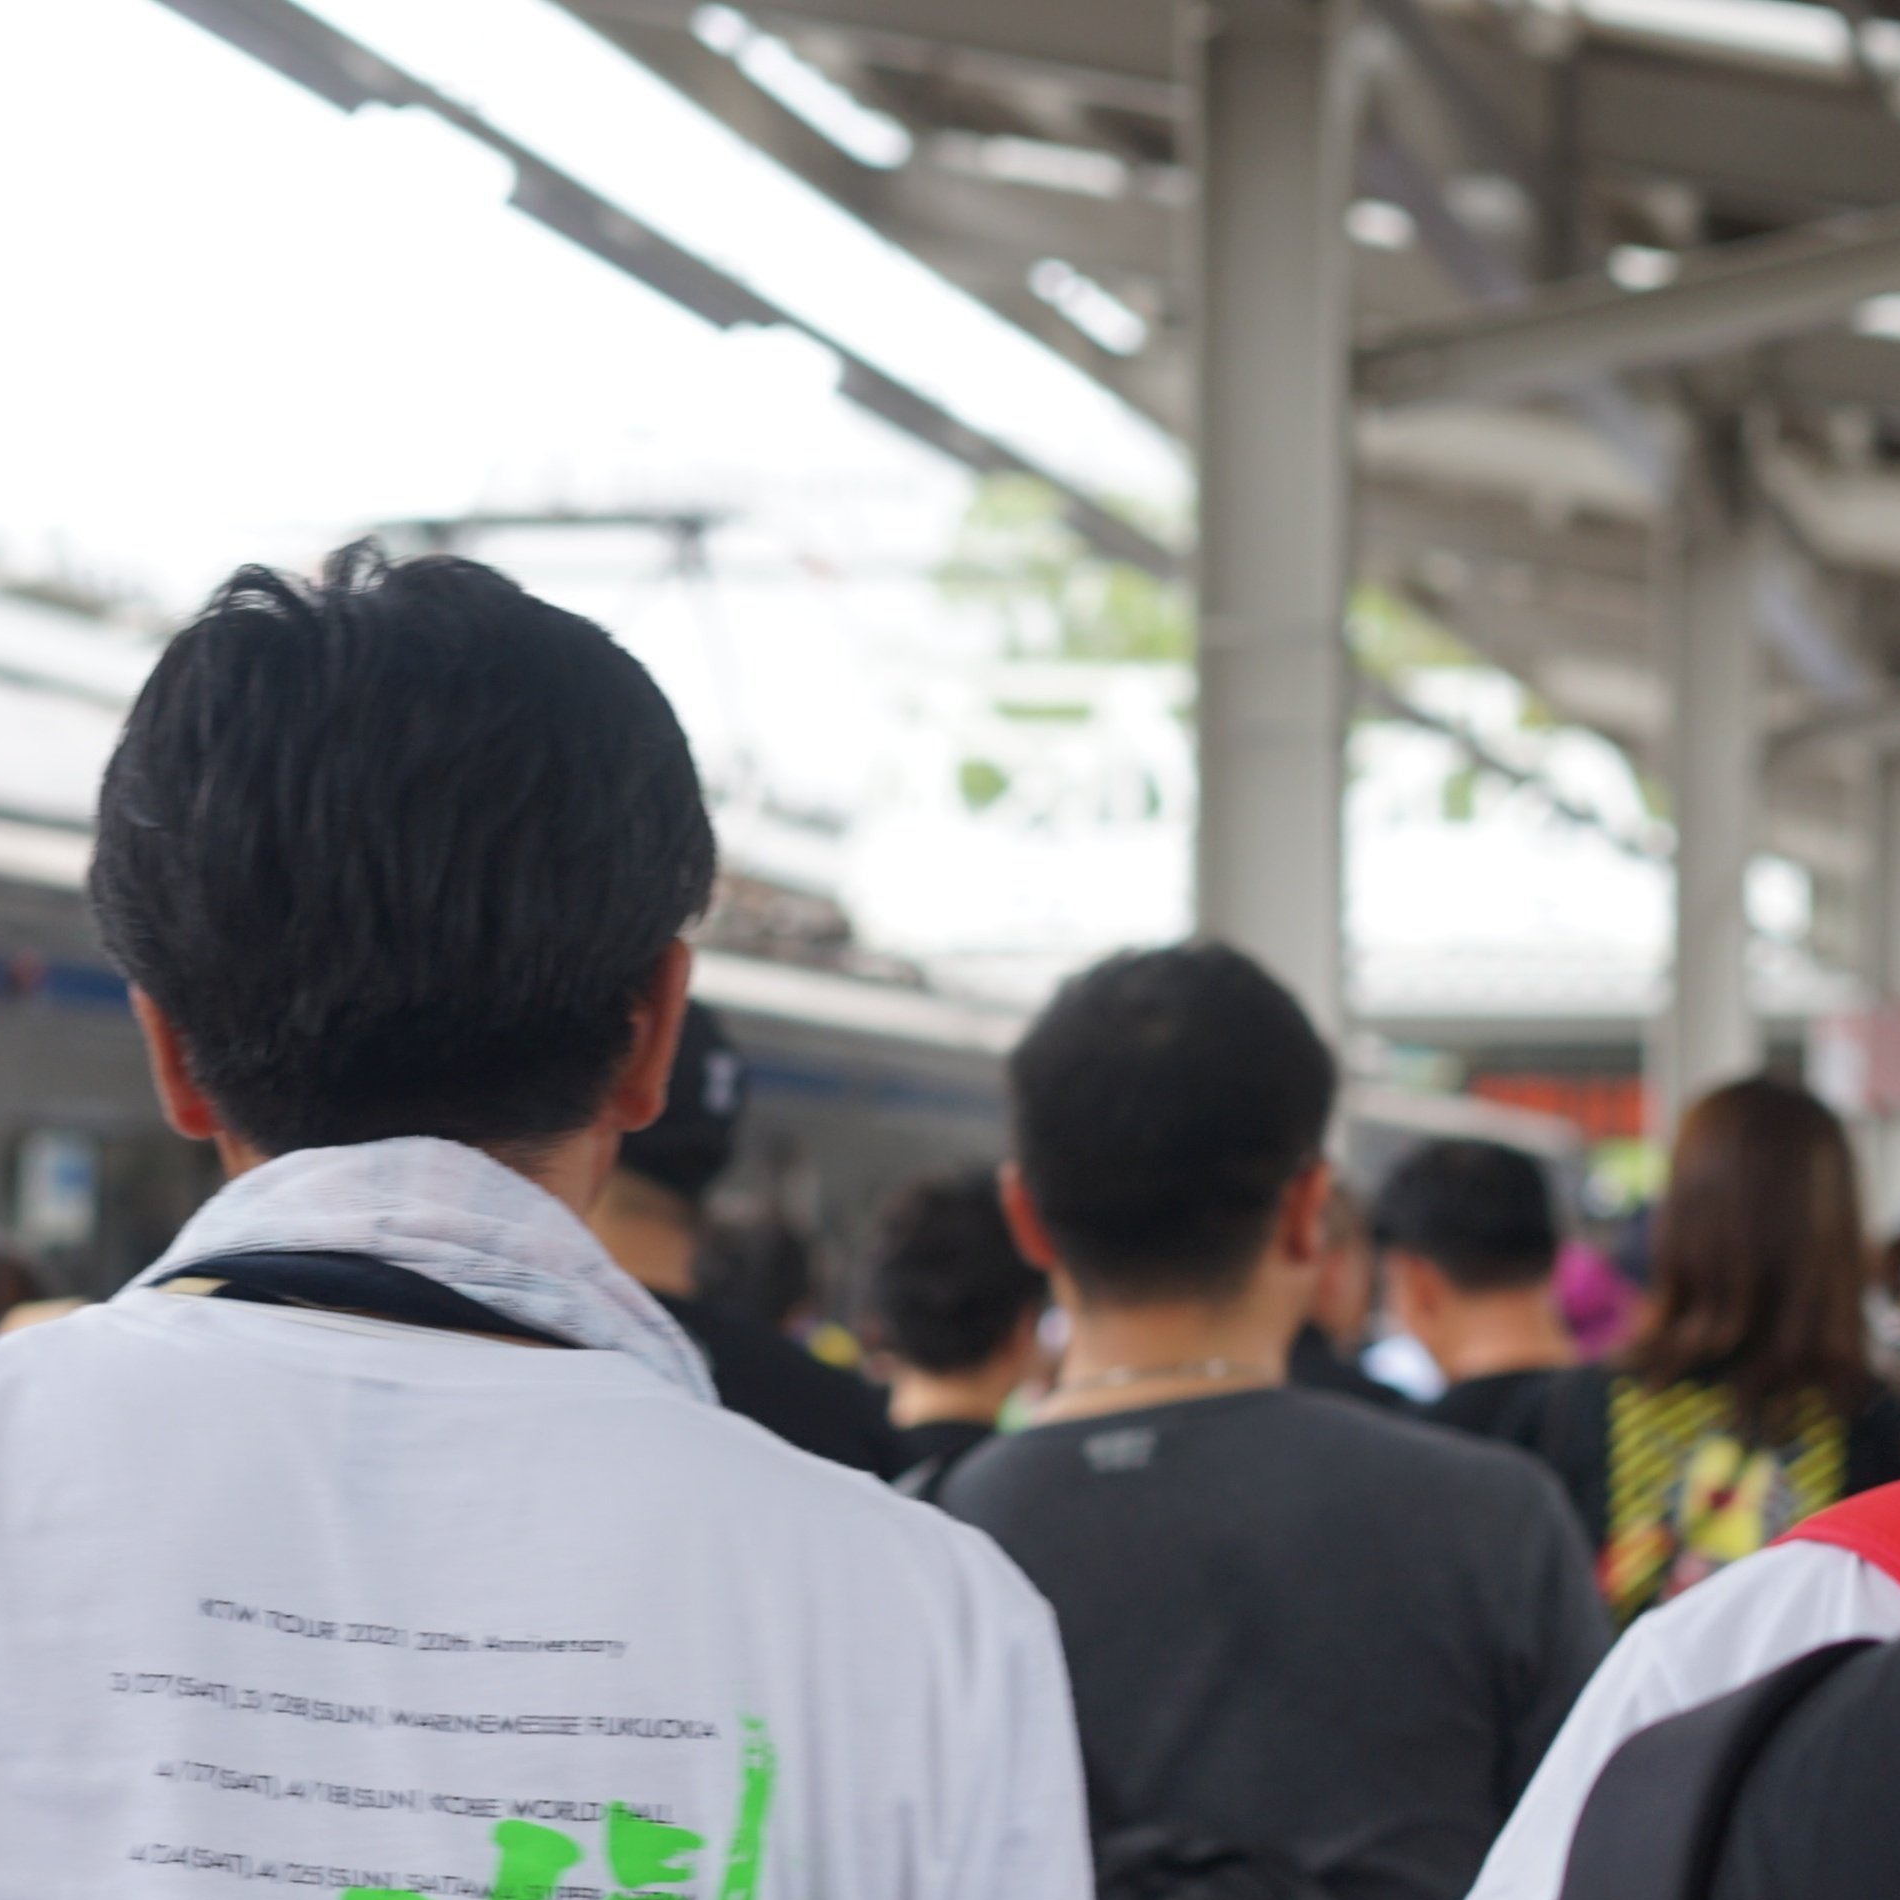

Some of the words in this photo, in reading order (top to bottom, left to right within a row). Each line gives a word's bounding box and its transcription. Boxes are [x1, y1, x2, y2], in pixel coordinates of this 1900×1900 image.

[264, 1608, 338, 1640] TOUR
[482, 1635, 630, 1656] Anniversary
[588, 1717, 722, 1738] FUKUOKA
[430, 1793, 501, 1816] KOBE
[511, 1798, 607, 1820] WORLD
[607, 1802, 676, 1821] HALL
